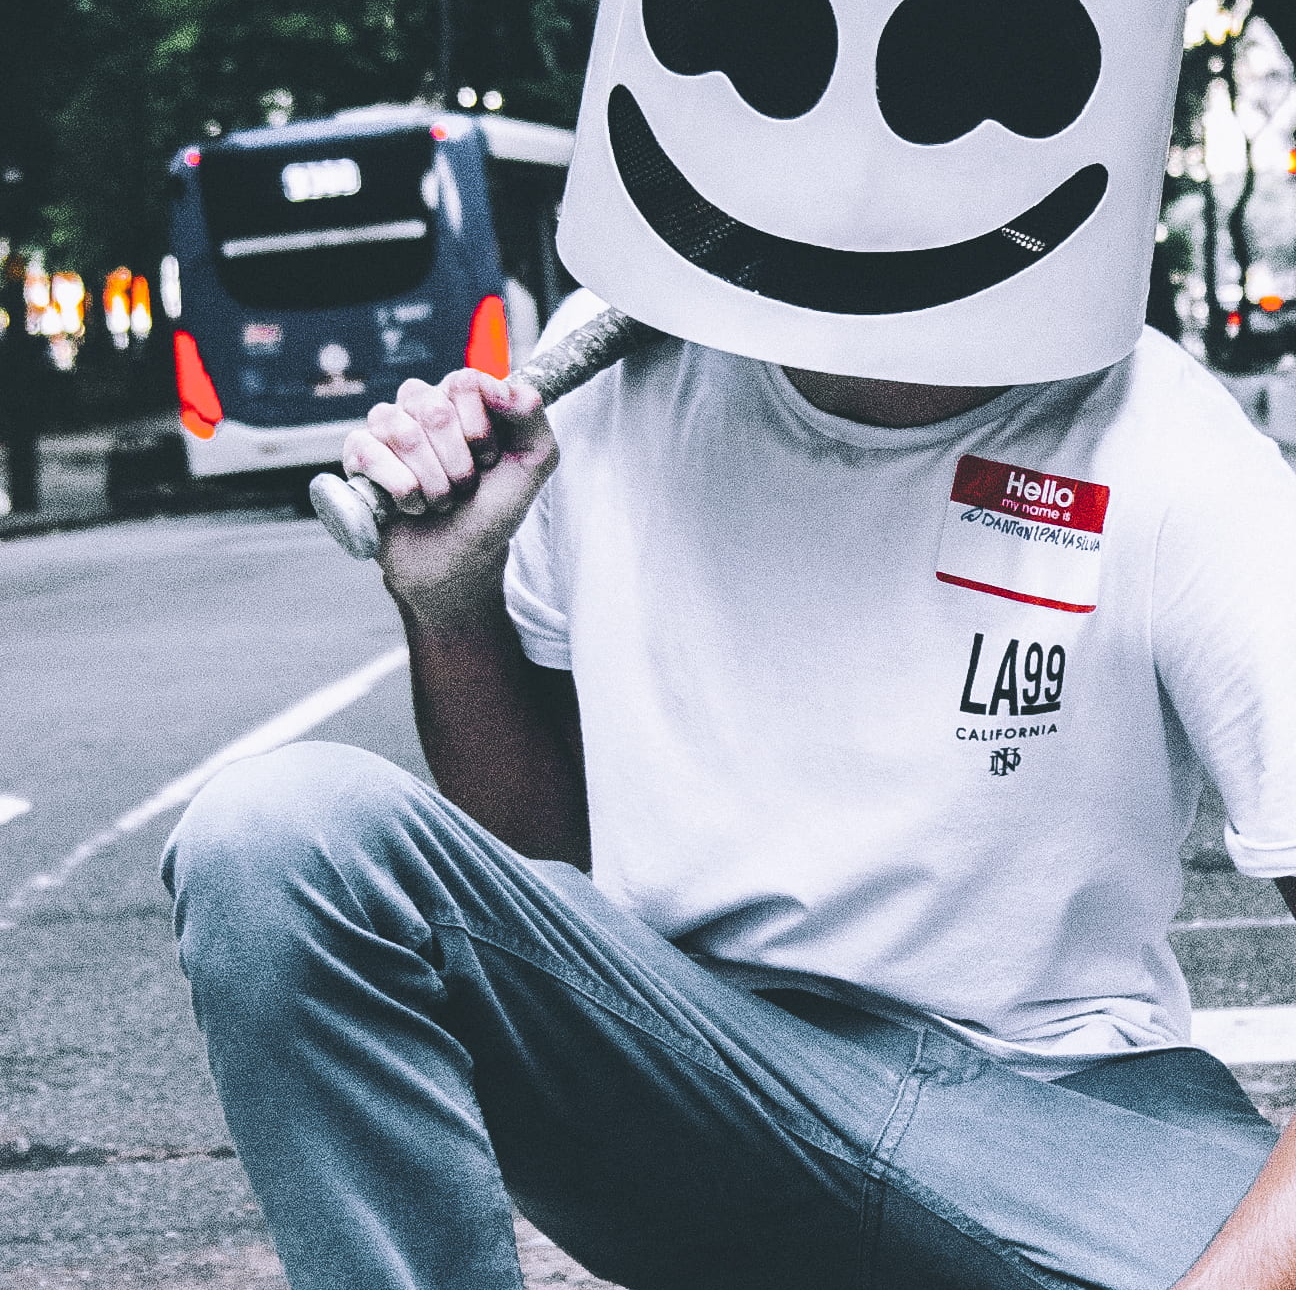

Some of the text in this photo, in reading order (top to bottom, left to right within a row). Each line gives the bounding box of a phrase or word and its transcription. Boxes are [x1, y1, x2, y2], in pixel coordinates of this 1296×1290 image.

[1006, 471, 1074, 508] Hello
[1002, 498, 1071, 522] my name is
[960, 632, 1066, 716] LA99
[956, 723, 1058, 742] CALIFORNIA
